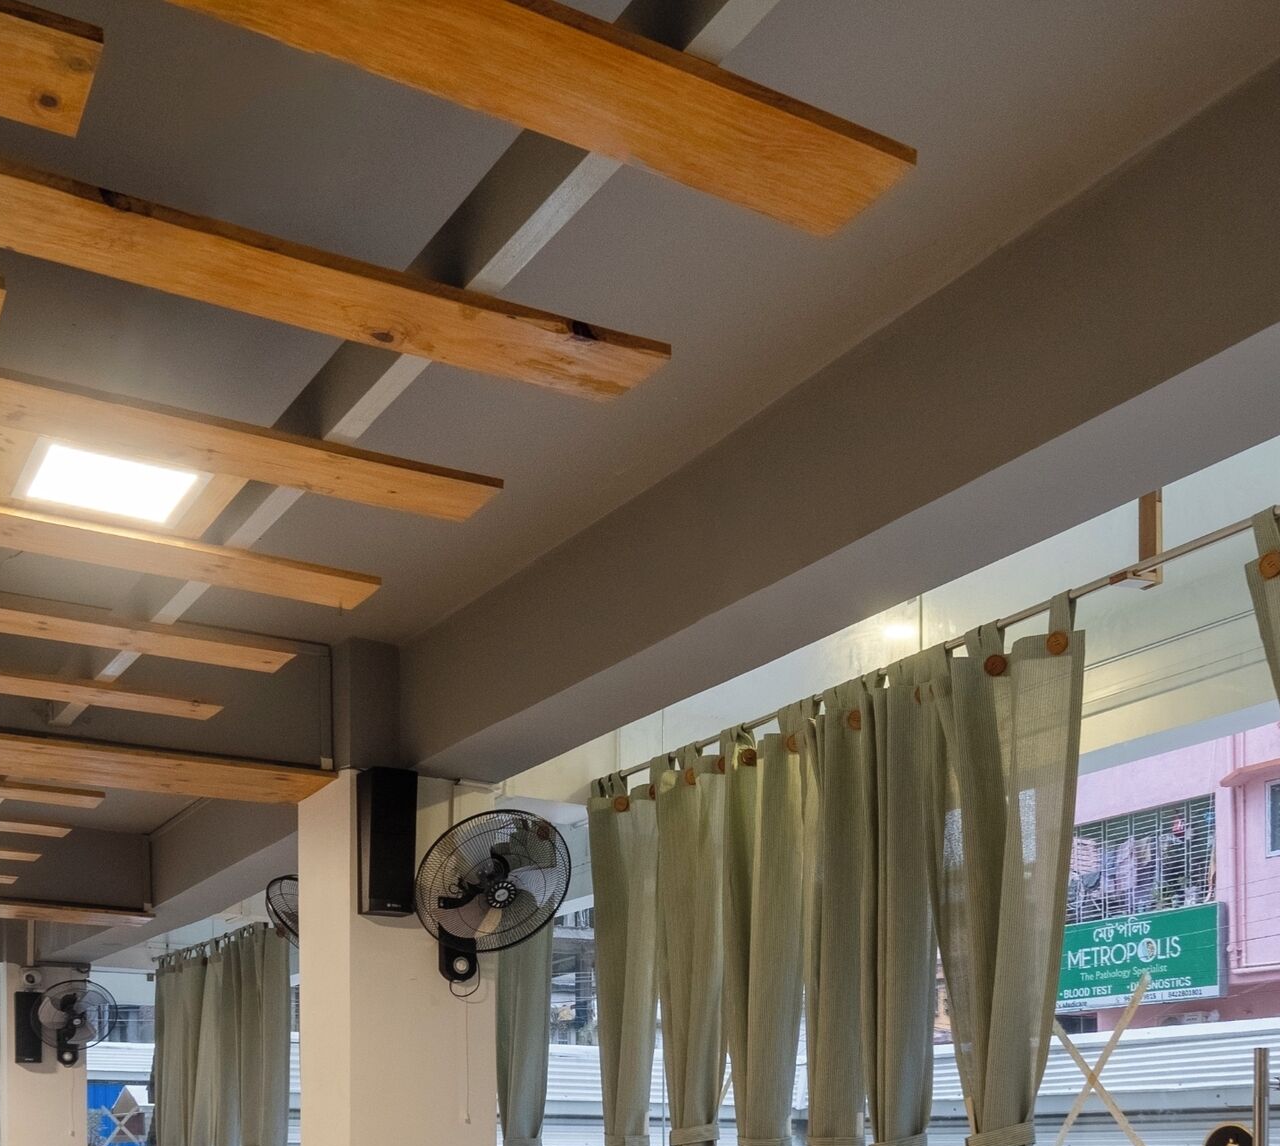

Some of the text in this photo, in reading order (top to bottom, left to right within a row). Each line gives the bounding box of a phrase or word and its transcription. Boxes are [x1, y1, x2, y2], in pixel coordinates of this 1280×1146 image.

[1067, 936, 1182, 970] METROPOLIS
[1080, 972, 1094, 981] The
[1095, 968, 1131, 980] Pathology
[1063, 985, 1112, 999] BLOOD TEST
